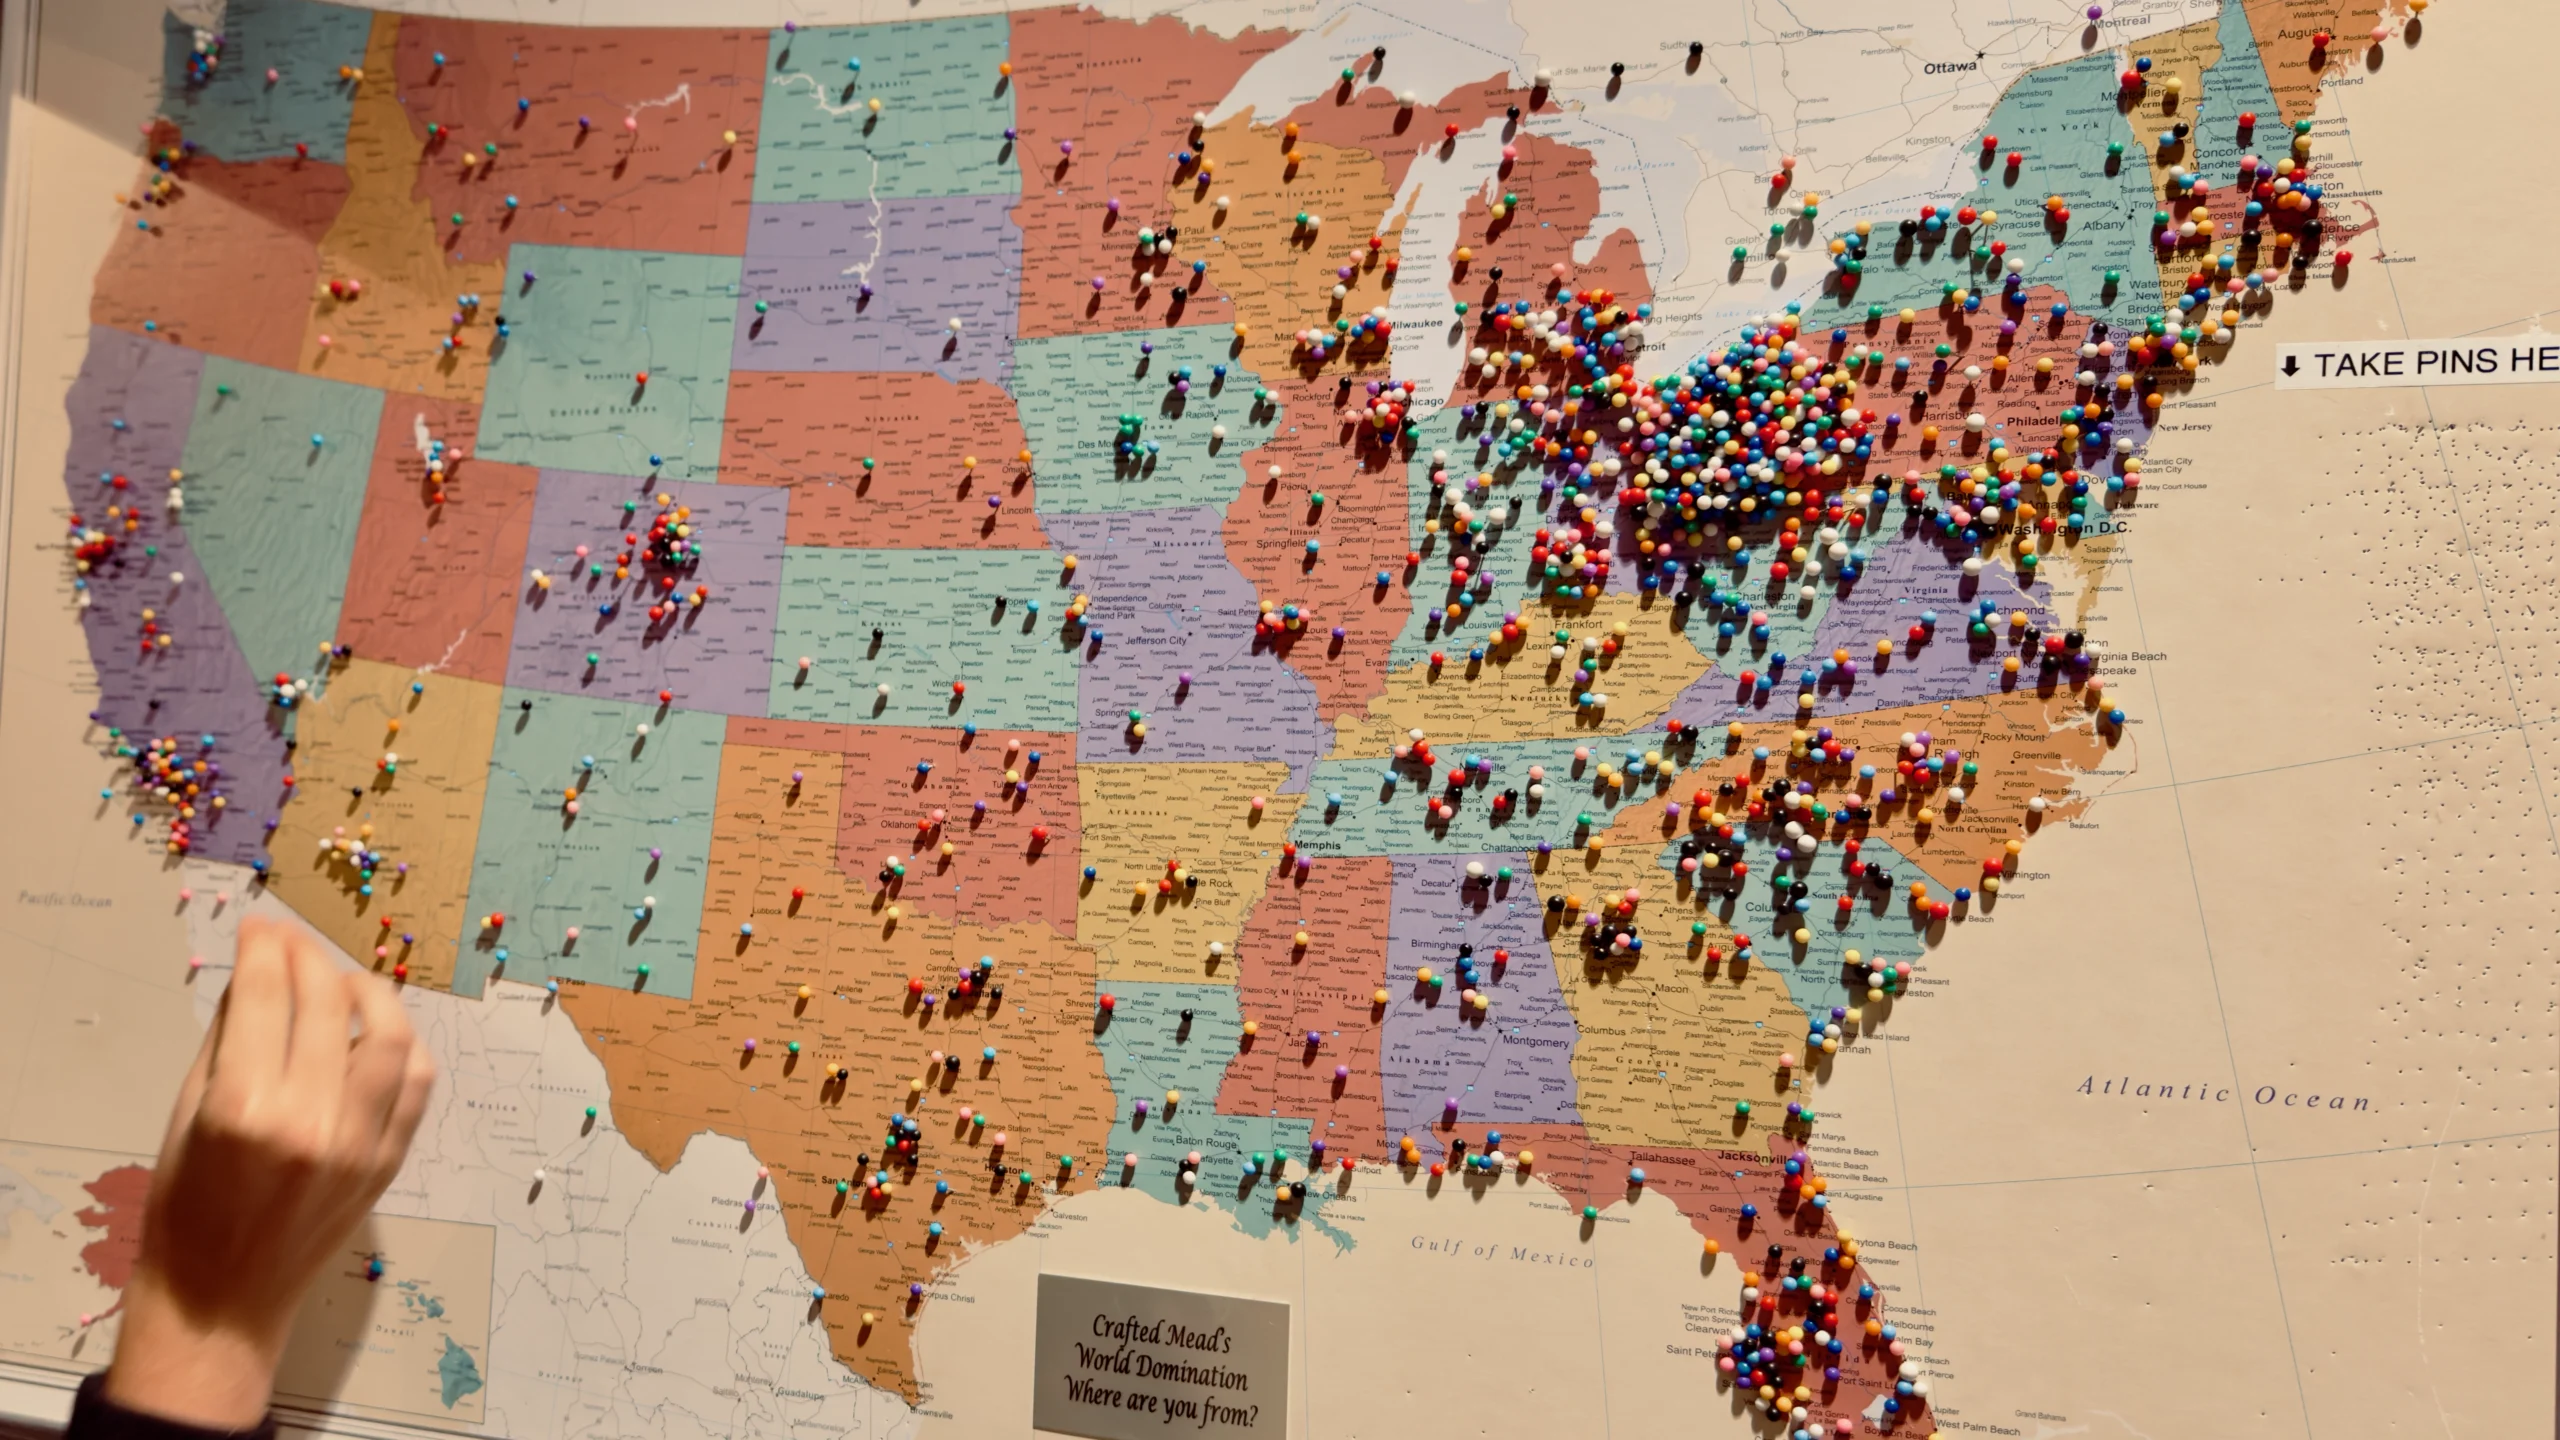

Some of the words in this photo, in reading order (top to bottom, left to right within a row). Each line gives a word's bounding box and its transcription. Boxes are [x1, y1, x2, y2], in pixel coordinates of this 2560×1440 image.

[1262, 6, 1296, 16] Thunder
[1299, 4, 1316, 14] Bay
[2293, 9, 2335, 19] Waterville
[1987, 17, 2037, 27] Hawkesbury
[2095, 15, 2151, 28] Montreal
[1780, 30, 1805, 39] North
[1807, 28, 1824, 37] Bay
[2278, 26, 2331, 41] Augusta
[1924, 60, 1977, 75] Ottawa
[2066, 63, 2113, 74] Plattsburgh
[2224, 82, 2263, 91] Hampshire
[2321, 77, 2363, 88] Portland
[2265, 84, 2311, 94] Westbrook
[2003, 89, 2052, 101] Ogdensburg
[2200, 115, 2237, 124] Lebanon
[2061, 123, 2099, 132] York
[1906, 136, 1951, 146] Kingston
[2263, 133, 2288, 142] Dover
[2193, 147, 2246, 159] Concord
[1866, 154, 1905, 164] Belleville
[2315, 160, 2363, 170] Gloucester
[1275, 188, 1344, 198] Wisconsin
[2322, 189, 2383, 199] Massachusetts
[2015, 198, 2038, 206] Utica
[2134, 201, 2153, 209] Troy
[1992, 219, 2041, 230] Syracuse
[2083, 220, 2125, 231] Albany
[1377, 229, 1399, 237] Green
[1401, 227, 1419, 236] Bay
[1725, 234, 1760, 246] Guelph
[2378, 256, 2416, 264] Nantucket
[2129, 278, 2186, 291] Waterbury
[1389, 319, 1443, 329] Milwaukee
[1392, 343, 1419, 351] Racine
[2314, 351, 2404, 377] TAKE
[2417, 348, 2498, 374] PINS
[2511, 346, 2560, 371] HE
[1226, 374, 1259, 385] Dubuque
[2008, 373, 2059, 383] Allentown
[1292, 391, 1331, 402] Rockford
[1998, 400, 2036, 409] Reading
[2159, 424, 2179, 432] New
[2182, 423, 2212, 432] Jersey
[1281, 482, 1308, 492] Peoria
[1339, 503, 1386, 513] Bloomington
[2115, 501, 2159, 509] Delaware
[1001, 506, 1031, 516] Lincoln
[2099, 521, 2132, 533] D.C.
[1153, 540, 1212, 548] Missouri
[1256, 538, 1306, 549] Springfield
[2086, 546, 2125, 554] Salisbury
[1904, 586, 1949, 595] Virginia
[1091, 593, 1147, 603] Independence
[1735, 591, 1795, 602] Charleston
[1148, 601, 1182, 610] Columbia
[1554, 620, 1602, 630] Frankfort
[1125, 635, 1164, 646] Jefferson
[1166, 635, 1187, 646] City
[2131, 651, 2167, 661] Beach
[1366, 657, 1409, 668] Evansville
[1511, 693, 1568, 704] Kentucky
[1877, 699, 1914, 709] Danville
[1424, 712, 1450, 721] Bowling
[1453, 713, 1474, 721] Green
[1983, 732, 2012, 743] Rocky
[2015, 733, 2045, 742] Mount
[2013, 751, 2061, 761] Greenville
[2082, 769, 2126, 778] Swanquarter
[1096, 791, 1136, 802] Fayetteville
[1108, 807, 1168, 817] Arkansas
[1962, 814, 2019, 824] Jacksonville
[1937, 824, 1965, 834] North
[1966, 826, 2007, 835] Carolina
[2070, 822, 2100, 830] Beaufort
[1294, 840, 1341, 850] Memphis
[1922, 848, 1965, 858] Lumberton
[1386, 861, 1416, 869] Florence
[1208, 878, 1232, 887] Rock
[1422, 879, 1452, 888] Decatur
[18, 890, 64, 906] Pacific
[70, 893, 112, 908] Ocean
[1196, 898, 1212, 906] Pine
[1213, 898, 1230, 906] Bluff
[752, 908, 782, 916] Lubbock
[1509, 911, 1542, 920] Gadsden
[1663, 906, 1693, 915] Athens
[836, 984, 863, 994] Abilene
[1655, 984, 1689, 994] Macon
[1282, 988, 1364, 1001] Mississippi
[1576, 1024, 1626, 1037] Columbus
[1503, 1035, 1570, 1049] Montgomery
[1389, 1055, 1449, 1066] Alabama
[1570, 1054, 1597, 1062] Eufaula
[1616, 1056, 1679, 1068] Georgia
[1632, 1074, 1662, 1085] Albany
[1713, 1080, 1744, 1089] Douglas
[1494, 1091, 1531, 1100] Enterprise
[2078, 1075, 2229, 1102] Atlantic
[2255, 1085, 2370, 1111] Ocean
[1560, 1101, 1591, 1110] Dothan
[1176, 1136, 1204, 1146] Baton
[1206, 1139, 1237, 1150] Rouge
[1807, 1144, 1851, 1156] Fernandina
[1853, 1147, 1879, 1157] Beach
[1629, 1152, 1695, 1167] Tallahassee
[1812, 1159, 1841, 1168] Atlantic
[1843, 1162, 1869, 1170] Beach
[1812, 1170, 1860, 1182] Jacksonville
[1862, 1175, 1888, 1183] Beach
[1034, 1186, 1074, 1197] Pasadena
[1823, 1190, 1841, 1199] Saint
[1843, 1192, 1883, 1203] Augustine
[1052, 1210, 1088, 1222] Galveston
[1411, 1236, 1463, 1255] Gulf
[1474, 1244, 1499, 1261] of
[1510, 1246, 1593, 1268] Mexico
[1857, 1255, 1899, 1267] Edgewater
[824, 1292, 849, 1301] Laredo
[921, 1290, 946, 1301] Corpus
[948, 1293, 975, 1304] Christi
[1884, 1318, 1935, 1332] Melbourne
[1093, 1314, 1165, 1347] Crafted
[1166, 1324, 1231, 1354] Mead's
[1076, 1342, 1135, 1375] World
[1136, 1354, 1248, 1391] Domination
[777, 1386, 825, 1401] Guadalupe
[1064, 1374, 1122, 1408] Where
[1128, 1392, 1157, 1412] are
[1164, 1397, 1196, 1423] you
[1198, 1396, 1258, 1428] from?
[910, 1406, 953, 1420] Brownsville
[1932, 1405, 1960, 1417] Jupiter
[1937, 1419, 1961, 1430] West
[1963, 1422, 1986, 1433] Palm
[1988, 1425, 2021, 1437] Beach
